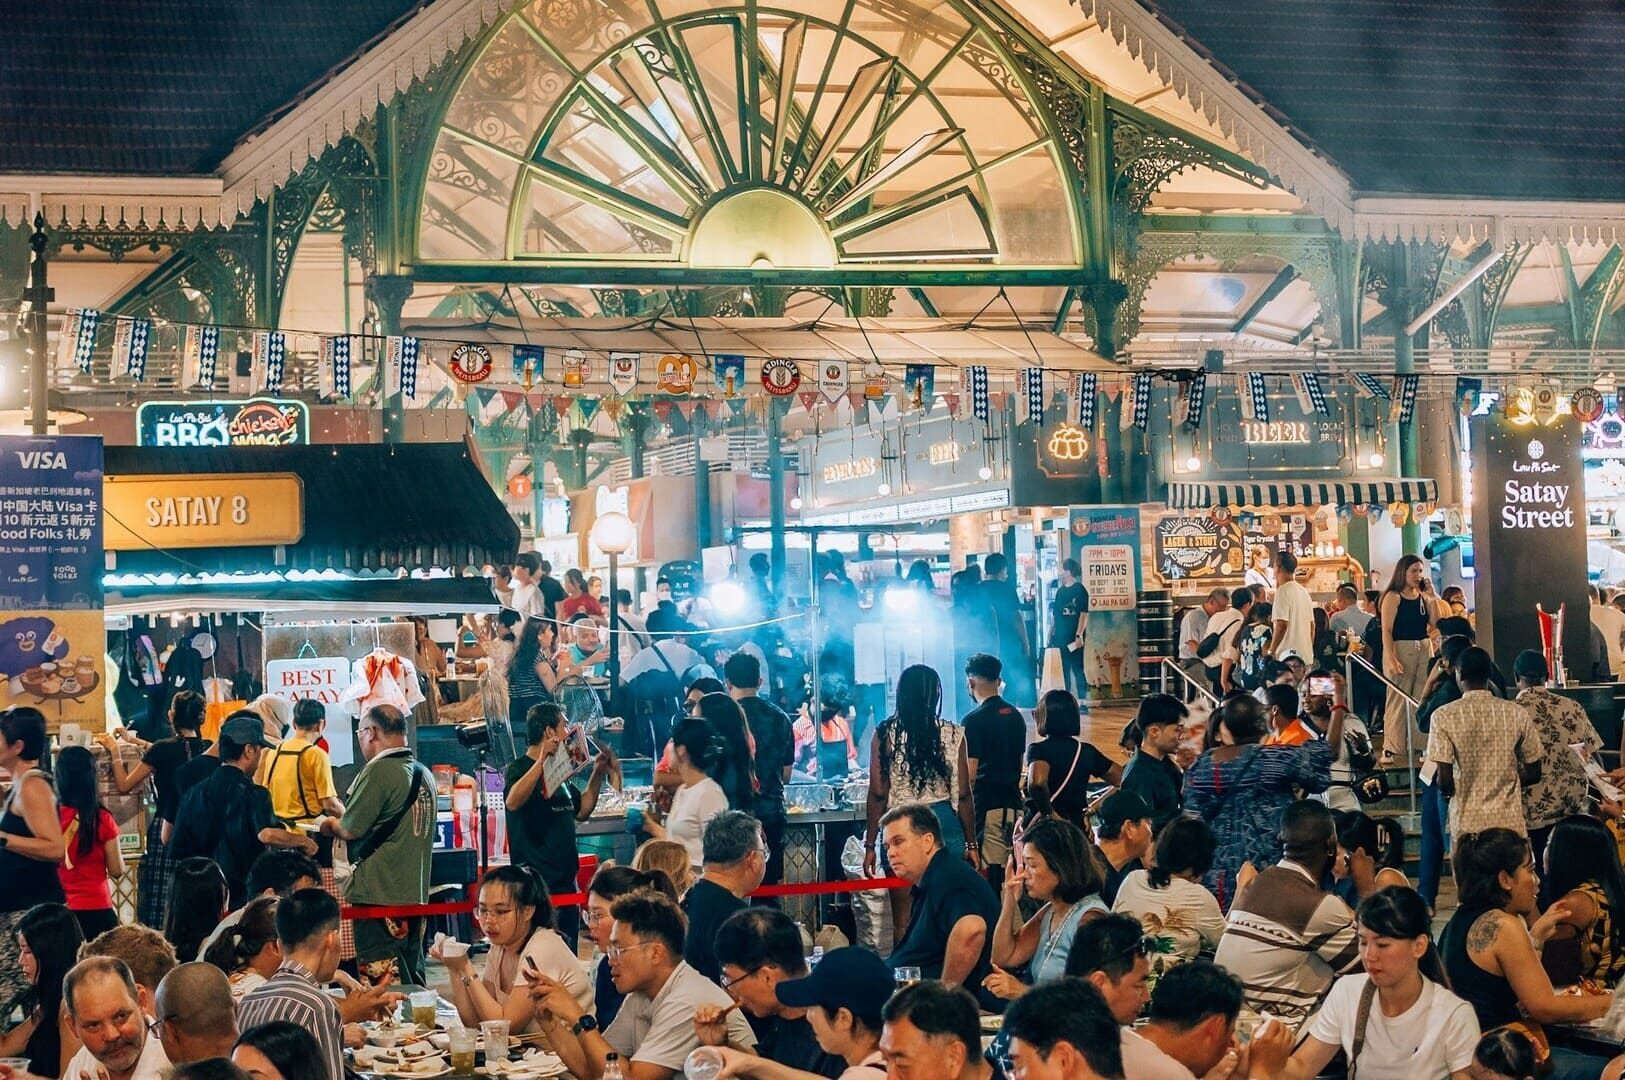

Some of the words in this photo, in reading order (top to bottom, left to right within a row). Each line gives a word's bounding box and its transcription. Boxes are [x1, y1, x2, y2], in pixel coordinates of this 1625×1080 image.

[393, 338, 401, 367] ERDINGER
[453, 345, 491, 361] ERDINGER
[763, 360, 798, 374] ERDINGER
[1243, 422, 1311, 443] BEER
[1319, 422, 1342, 431] LOCAL
[15, 451, 68, 470] VISA
[1505, 479, 1569, 509] Satay
[0, 500, 54, 513] 中国大陆
[56, 501, 83, 512] Visa
[86, 500, 98, 513] 卡
[146, 496, 223, 527] SATAY
[232, 495, 248, 525] 8
[4, 514, 19, 525] 10
[21, 514, 59, 526] 新元返
[61, 515, 69, 526] 5
[70, 514, 96, 527] 新元
[1502, 505, 1574, 528] Street
[0, 528, 27, 539] ood
[30, 528, 63, 540] Folks
[66, 528, 92, 541] 礼券
[1164, 536, 1187, 547] LAGER
[1195, 535, 1217, 547] STOUT
[1088, 549, 1103, 558] 7PM
[1110, 549, 1126, 558] 10PM
[54, 565, 76, 573] FOOD
[1089, 564, 1127, 576] FRIDAYS
[1099, 599, 1110, 608] LAU
[1110, 599, 1119, 607] PA
[1120, 598, 1129, 607] SAT
[281, 669, 336, 686] BEST
[275, 687, 342, 704] ATAY
